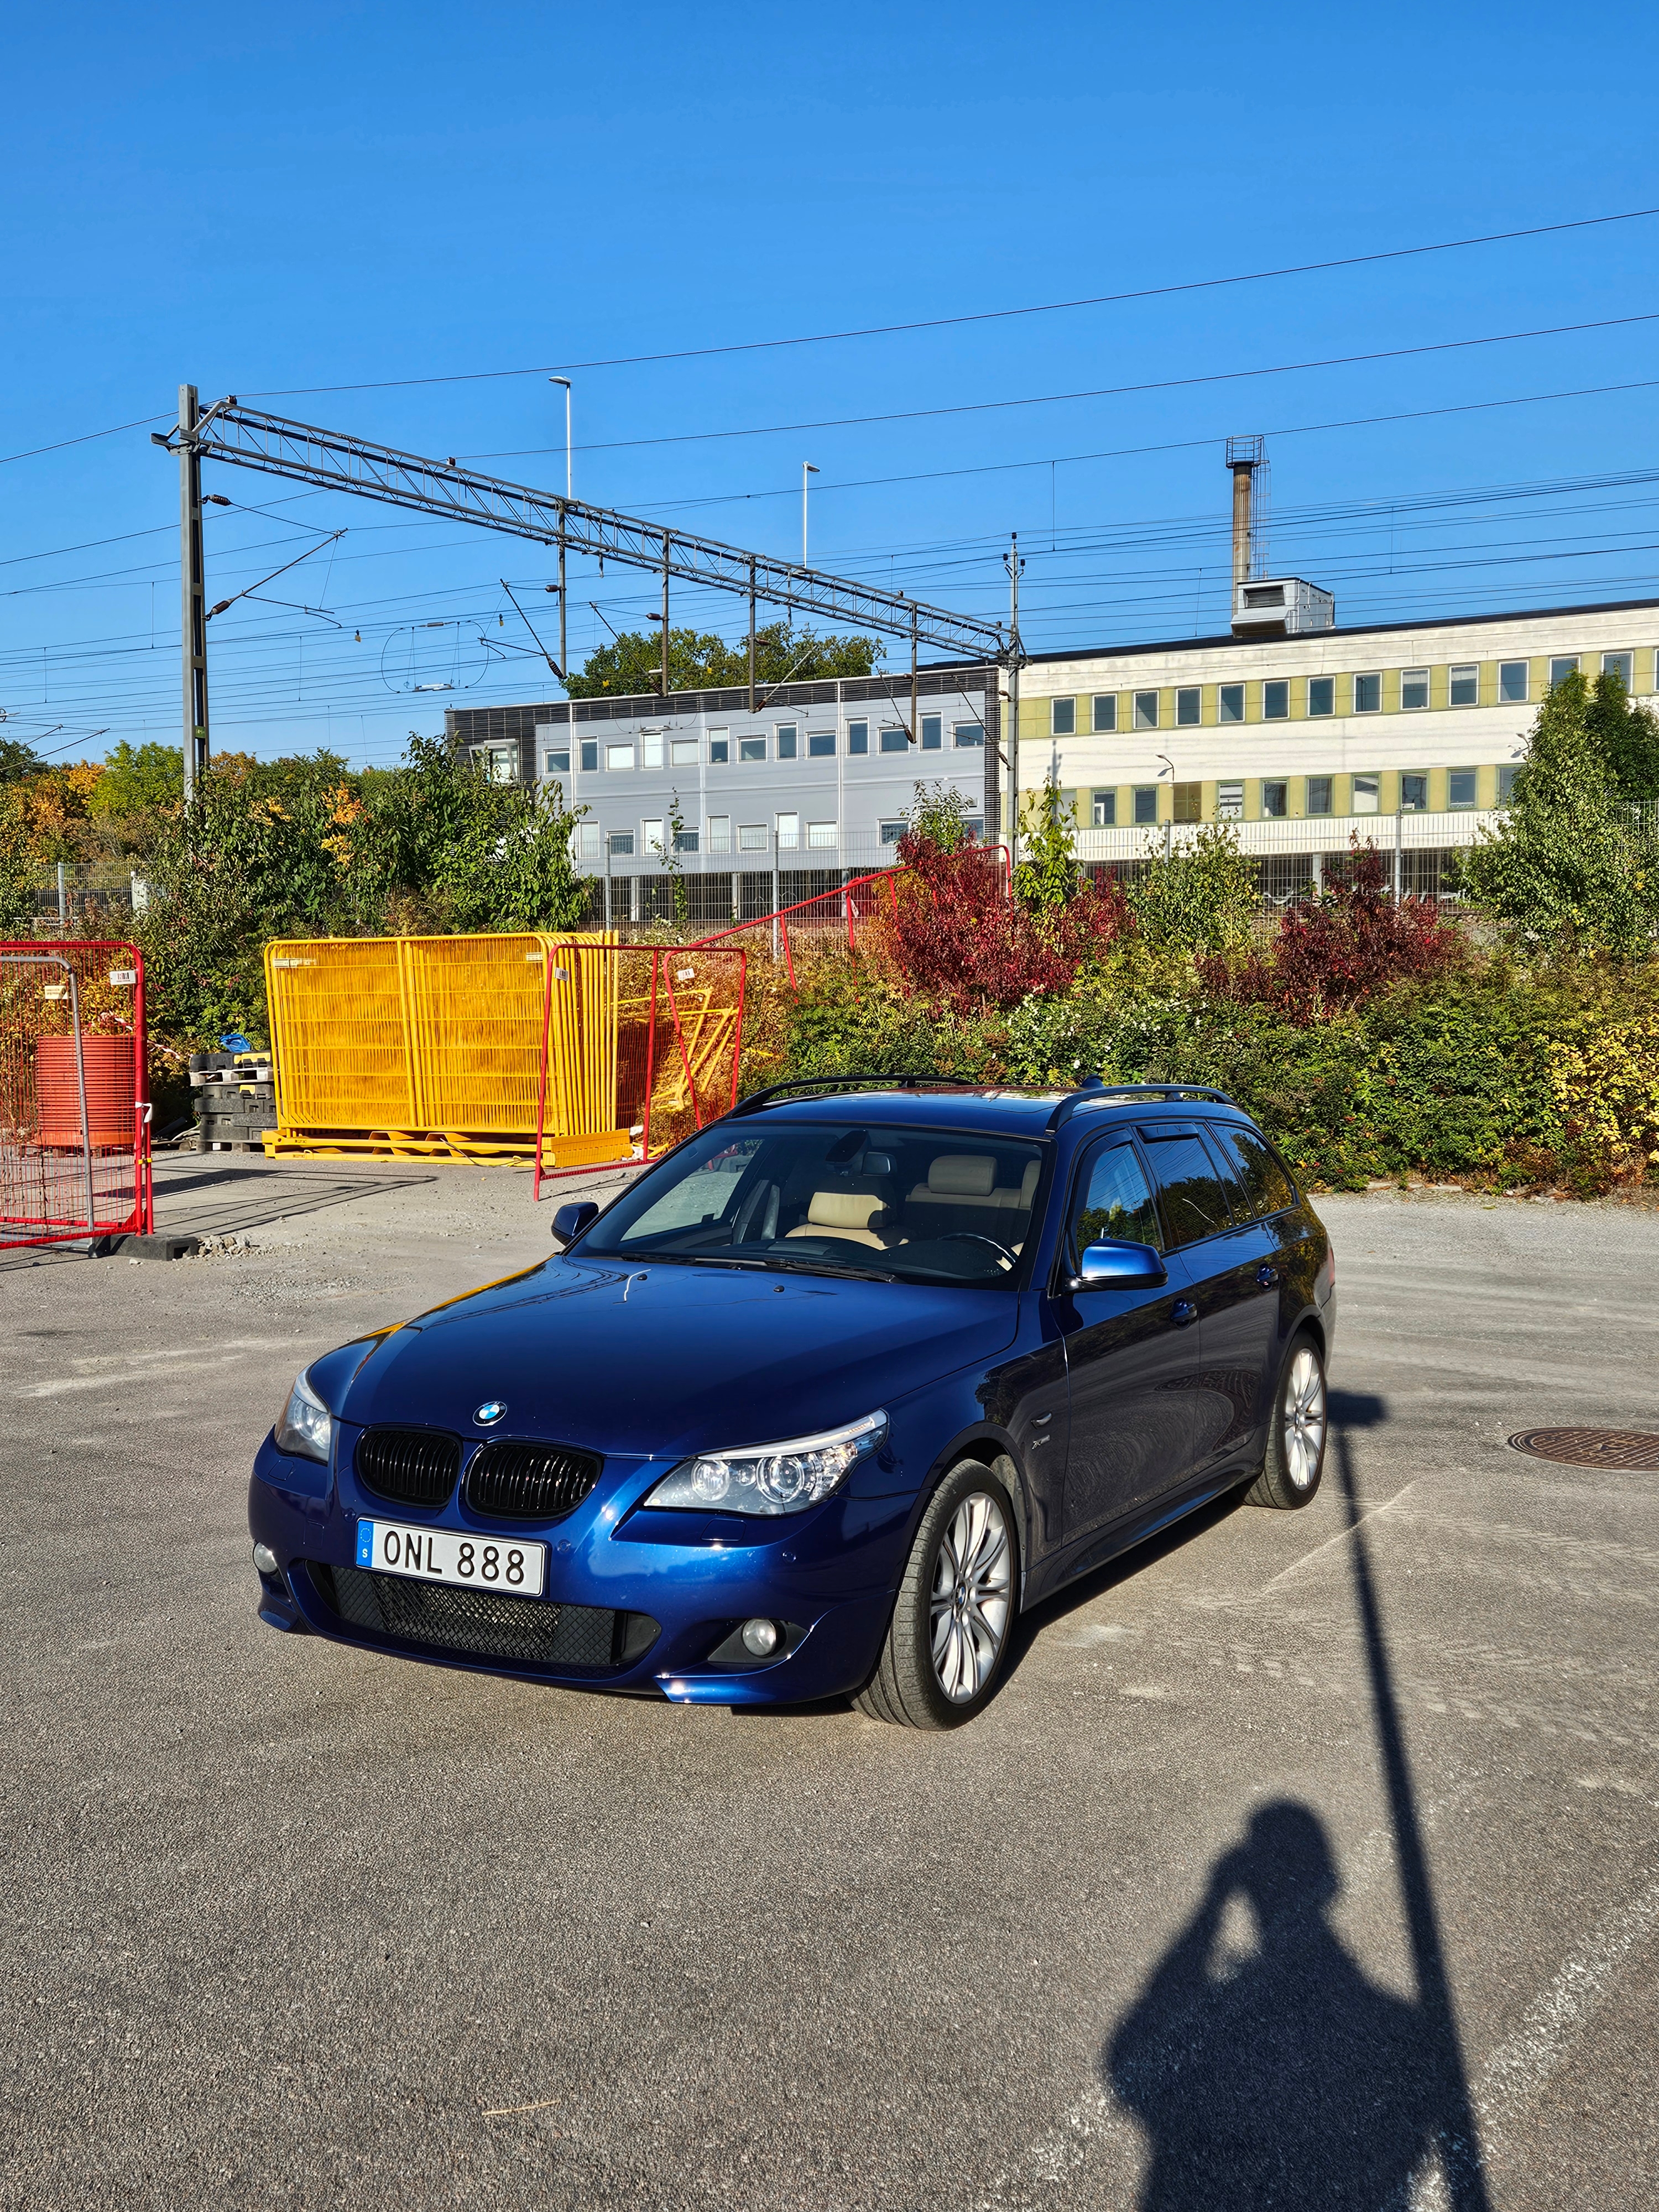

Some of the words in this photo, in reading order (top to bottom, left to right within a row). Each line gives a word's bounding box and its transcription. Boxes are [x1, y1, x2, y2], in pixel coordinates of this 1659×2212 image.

[362, 1548, 368, 1558] S
[384, 1530, 442, 1574] ONL
[457, 1542, 524, 1585] 888
